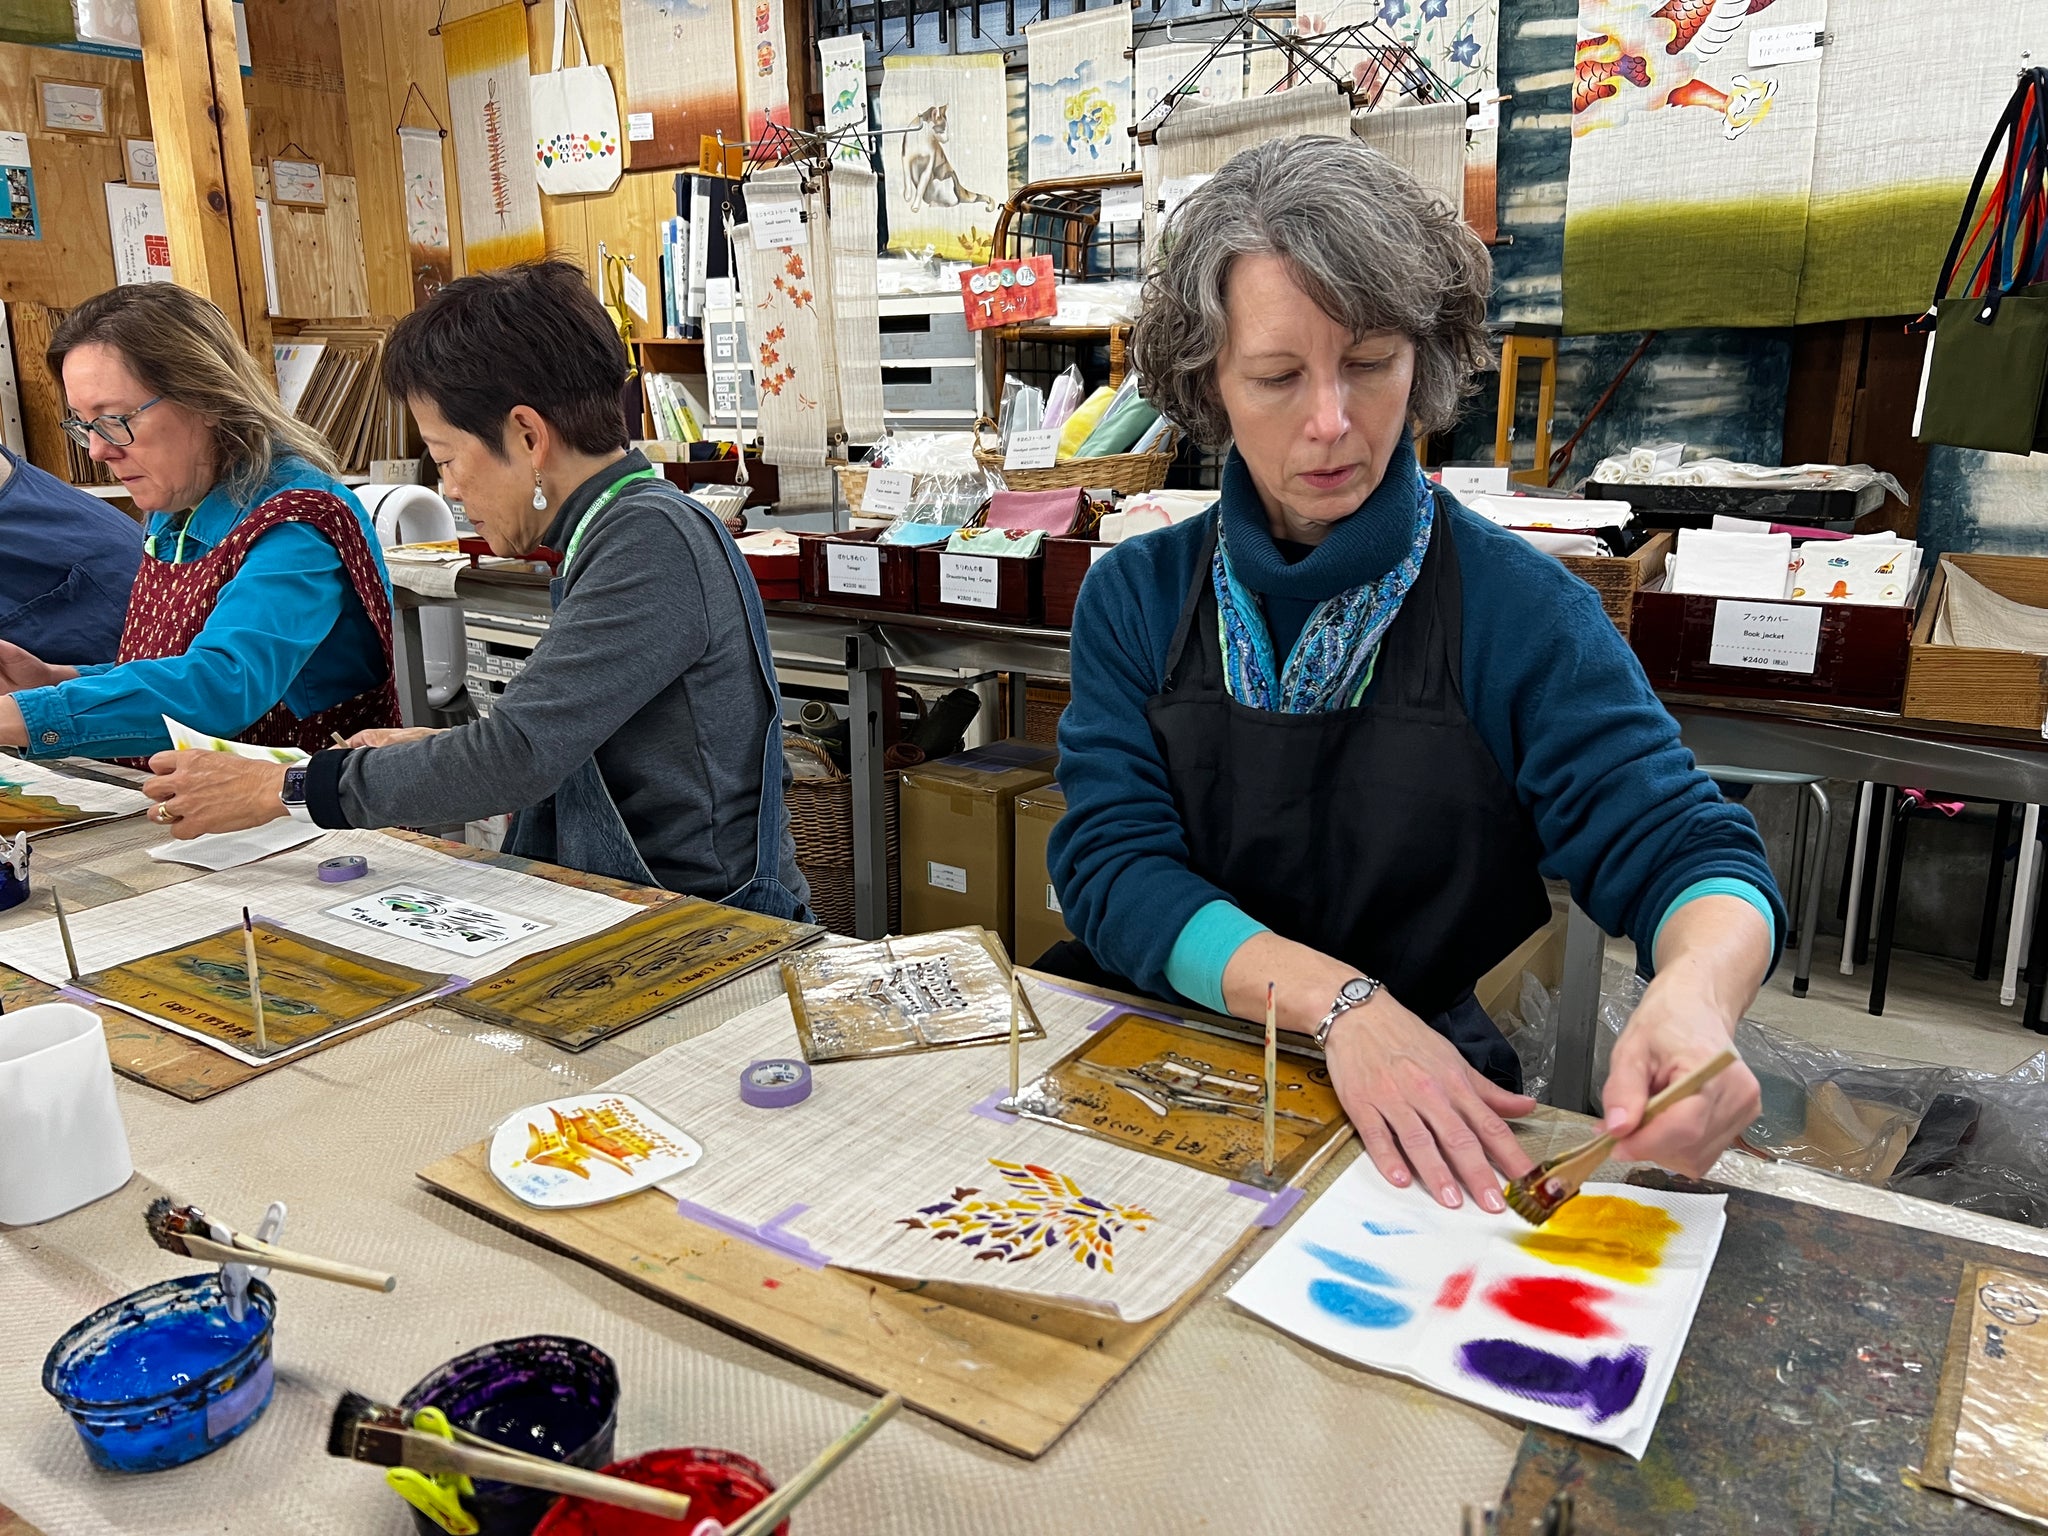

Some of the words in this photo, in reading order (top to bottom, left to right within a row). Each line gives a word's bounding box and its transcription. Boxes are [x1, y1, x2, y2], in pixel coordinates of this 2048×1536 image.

[978, 296, 1028, 317] Tシャツ
[1743, 613, 1789, 623] ブックカバー
[1761, 632, 1784, 640] jacket
[1742, 656, 1769, 665] ¥2400
